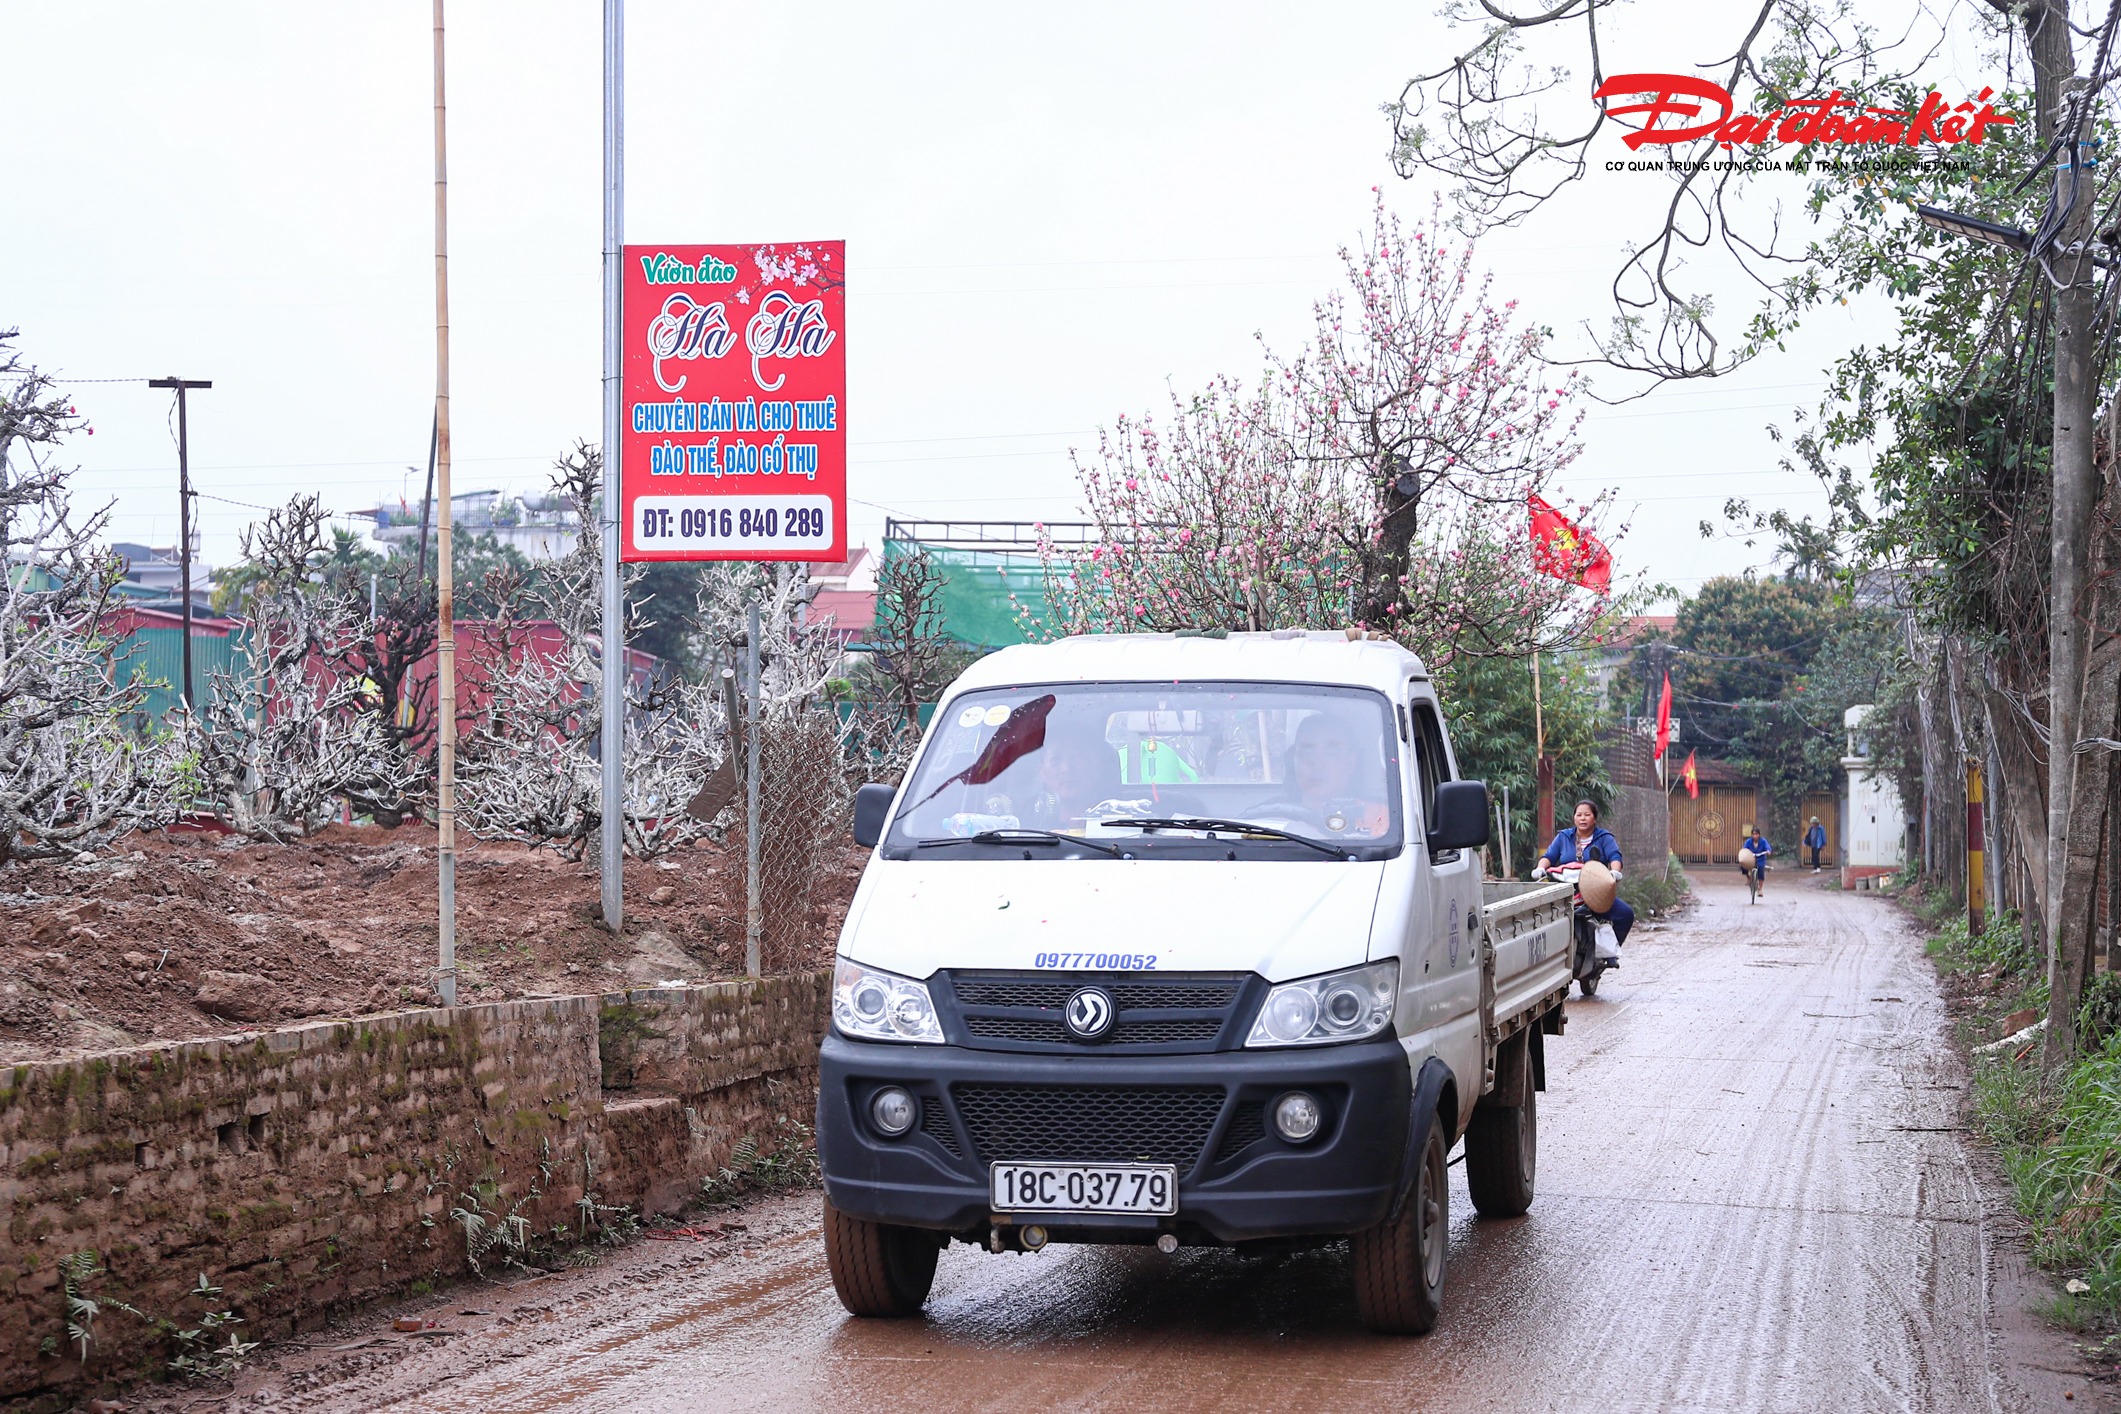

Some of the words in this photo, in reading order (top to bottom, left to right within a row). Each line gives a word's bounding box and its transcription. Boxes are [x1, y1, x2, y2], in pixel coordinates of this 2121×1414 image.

[641, 252, 695, 283] Vườn
[697, 255, 737, 283] đào
[648, 293, 737, 391] Hà
[746, 291, 836, 390] Hà
[633, 398, 695, 431] CHUYÊN
[699, 398, 732, 430] BÁN
[735, 397, 757, 430] VÀ
[760, 403, 792, 430] CHO
[796, 397, 836, 430] THUÊ
[652, 441, 684, 474] ĐÀO
[687, 437, 721, 477] THẾ,
[724, 440, 757, 474] ĐÀO
[761, 435, 784, 474] CỔ
[787, 445, 817, 479] THỤ
[643, 508, 674, 537] ĐT:
[680, 508, 732, 537] 0916
[739, 508, 778, 537] 840
[785, 508, 824, 537] 289
[1035, 953, 1157, 970] 0977700052
[1003, 1170, 1167, 1208] 18C-037.79
